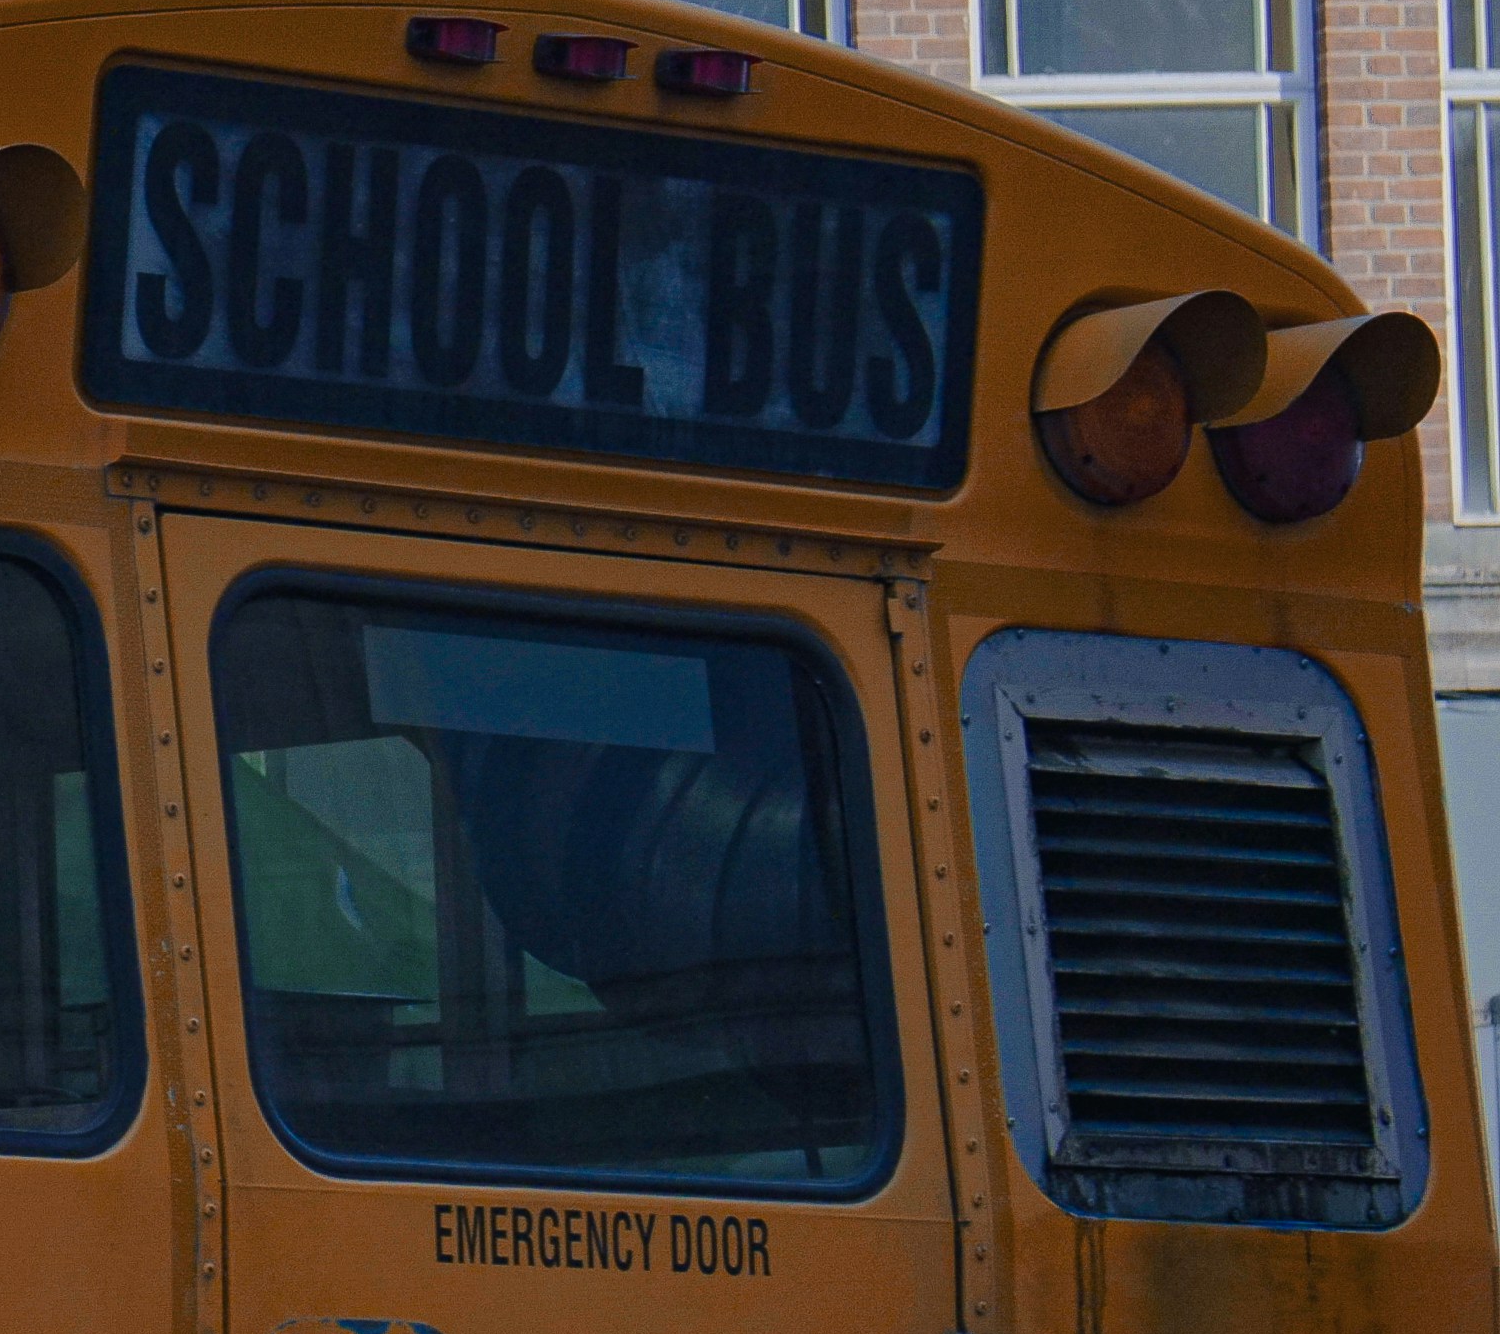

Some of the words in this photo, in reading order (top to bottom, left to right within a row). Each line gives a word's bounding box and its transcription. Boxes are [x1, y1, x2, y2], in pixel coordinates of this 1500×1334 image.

[135, 119, 644, 407] SCHOOL
[703, 190, 943, 441] BUS
[433, 1202, 663, 1273] EMERGENCY
[669, 1213, 774, 1278] DOOR
